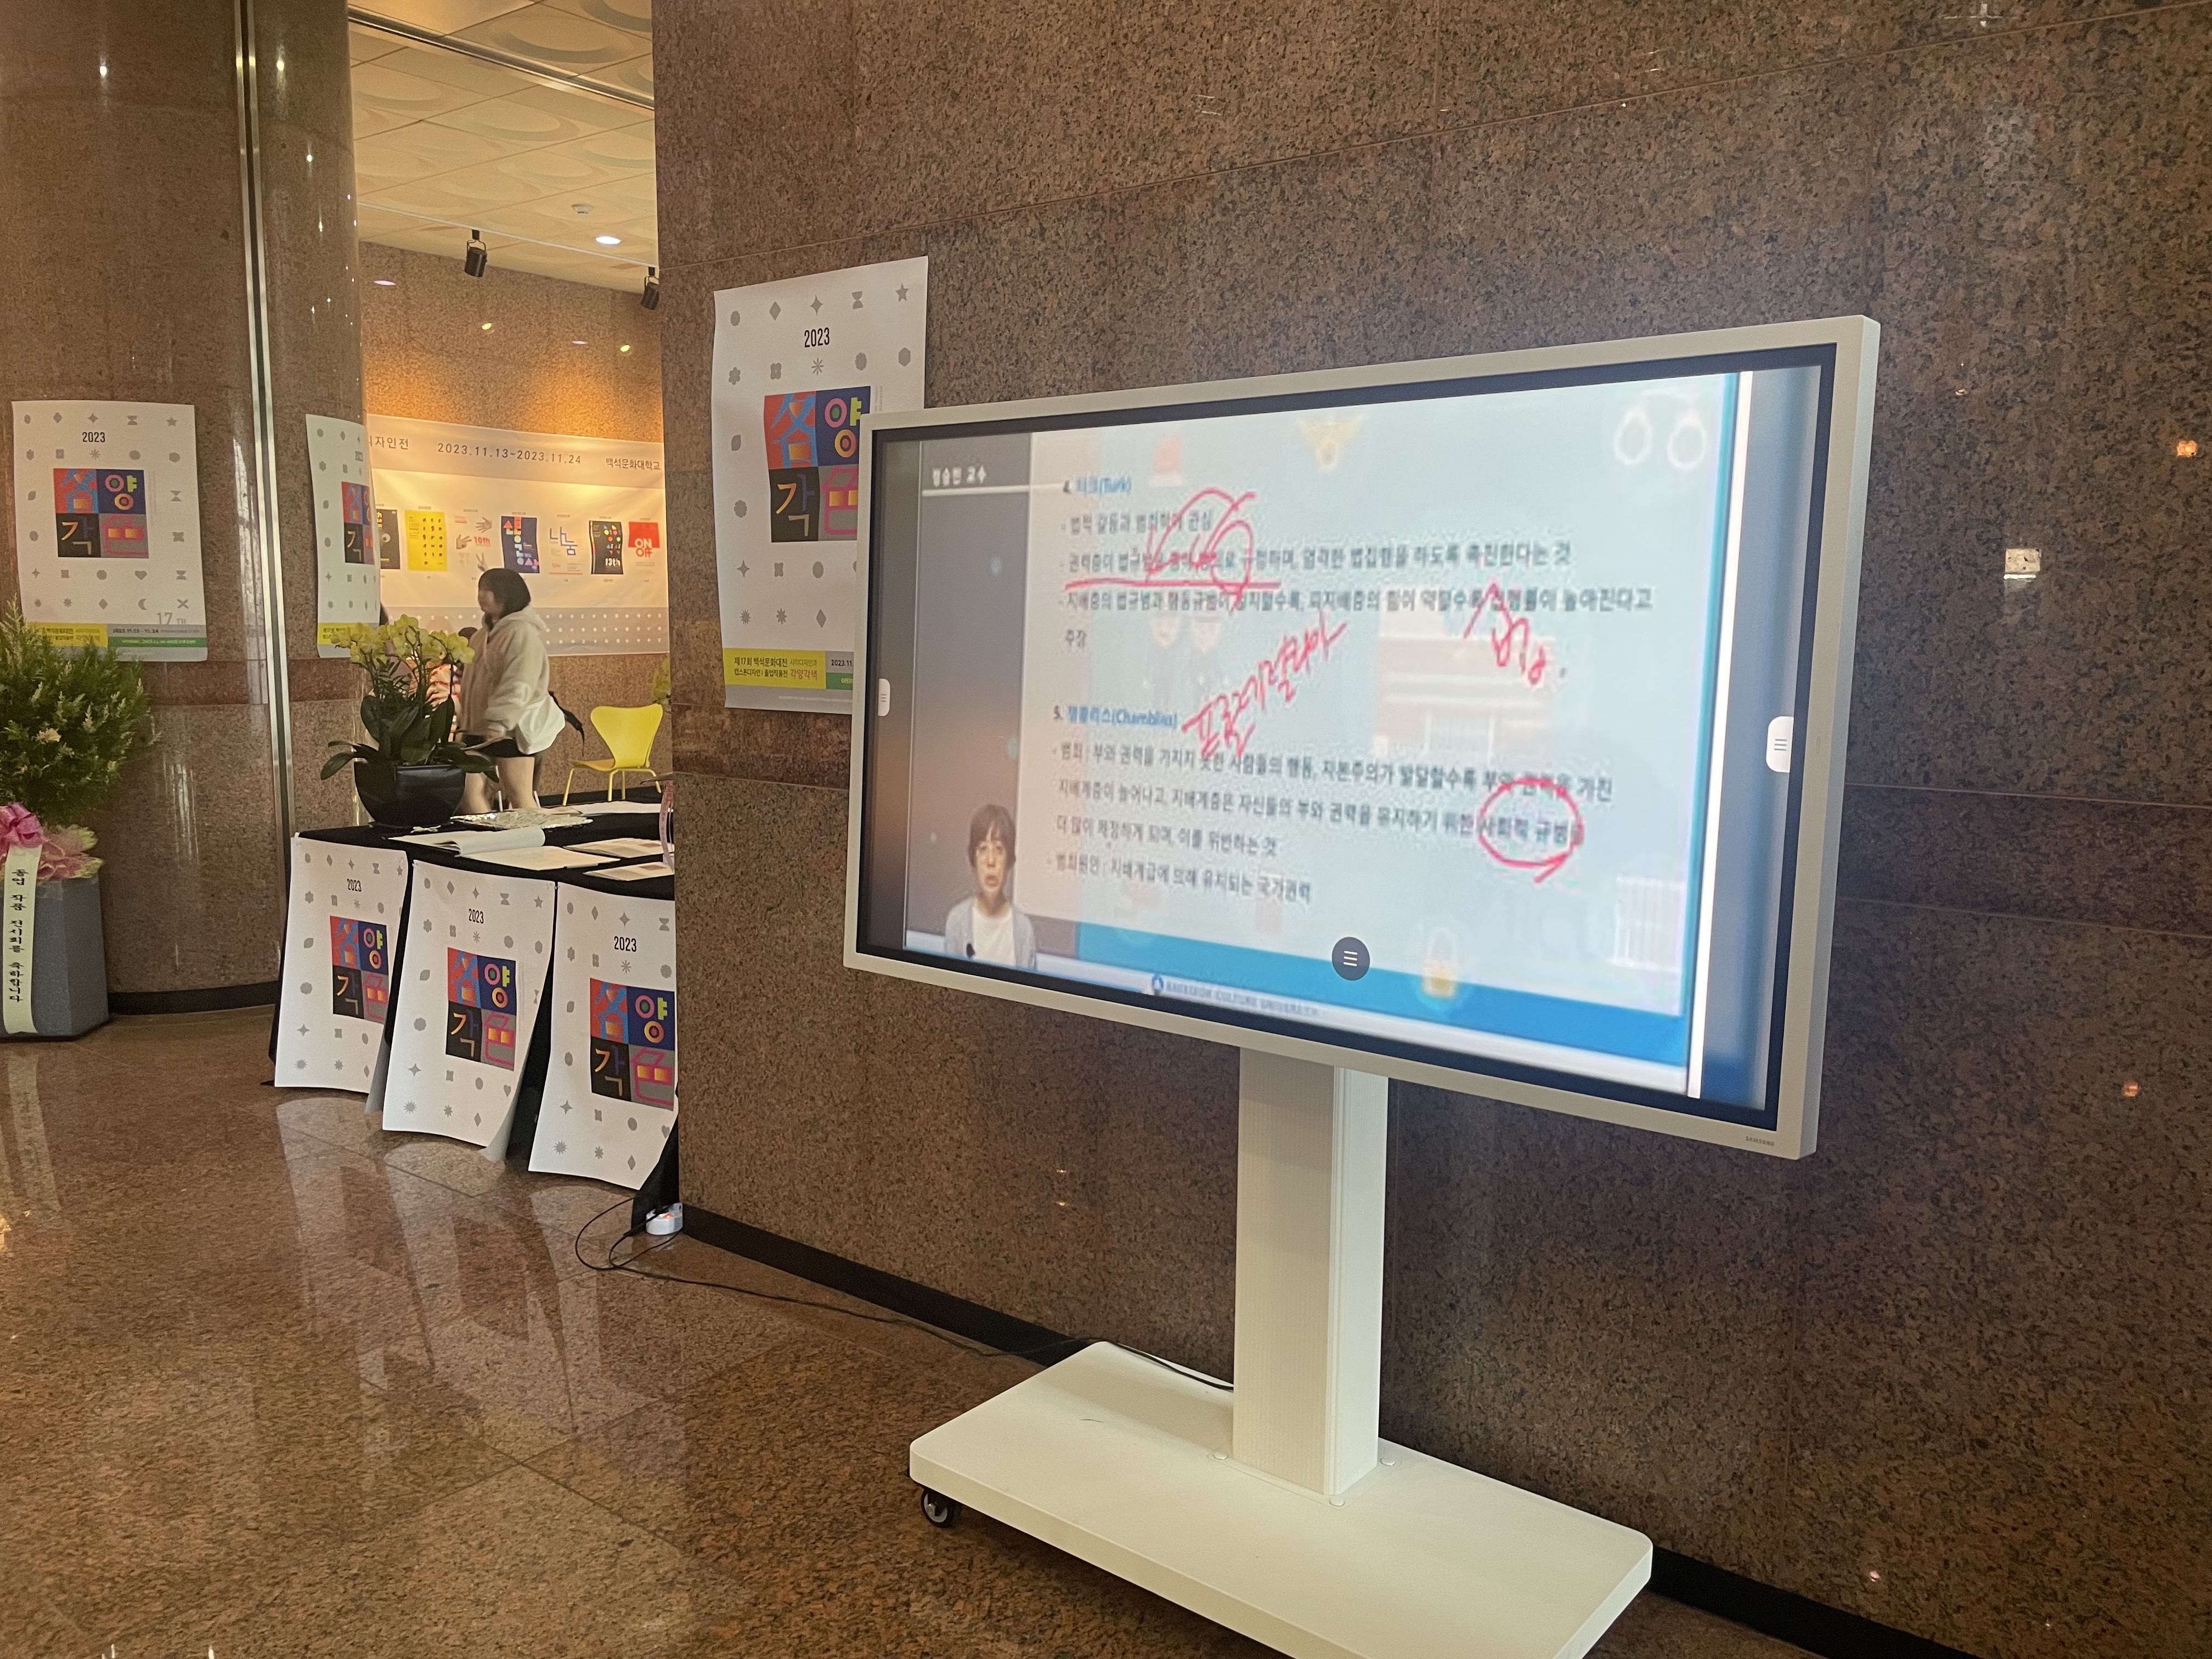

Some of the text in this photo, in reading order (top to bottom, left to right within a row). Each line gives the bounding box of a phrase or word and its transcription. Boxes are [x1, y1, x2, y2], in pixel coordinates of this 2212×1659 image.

[804, 328, 830, 348] 2023
[82, 432, 106, 443] 2023
[438, 443, 581, 464] 2023.11.13~2023.11.24
[605, 458, 662, 471] 백석문화대학교
[635, 538, 652, 548] ON
[605, 557, 620, 567] 13th
[156, 612, 173, 625] 17
[790, 669, 817, 680] 각양각색
[347, 878, 362, 893] 2023
[468, 909, 484, 924] 2023
[614, 935, 637, 953] 2023
[1745, 1136, 1775, 1147] SAMSUNG
